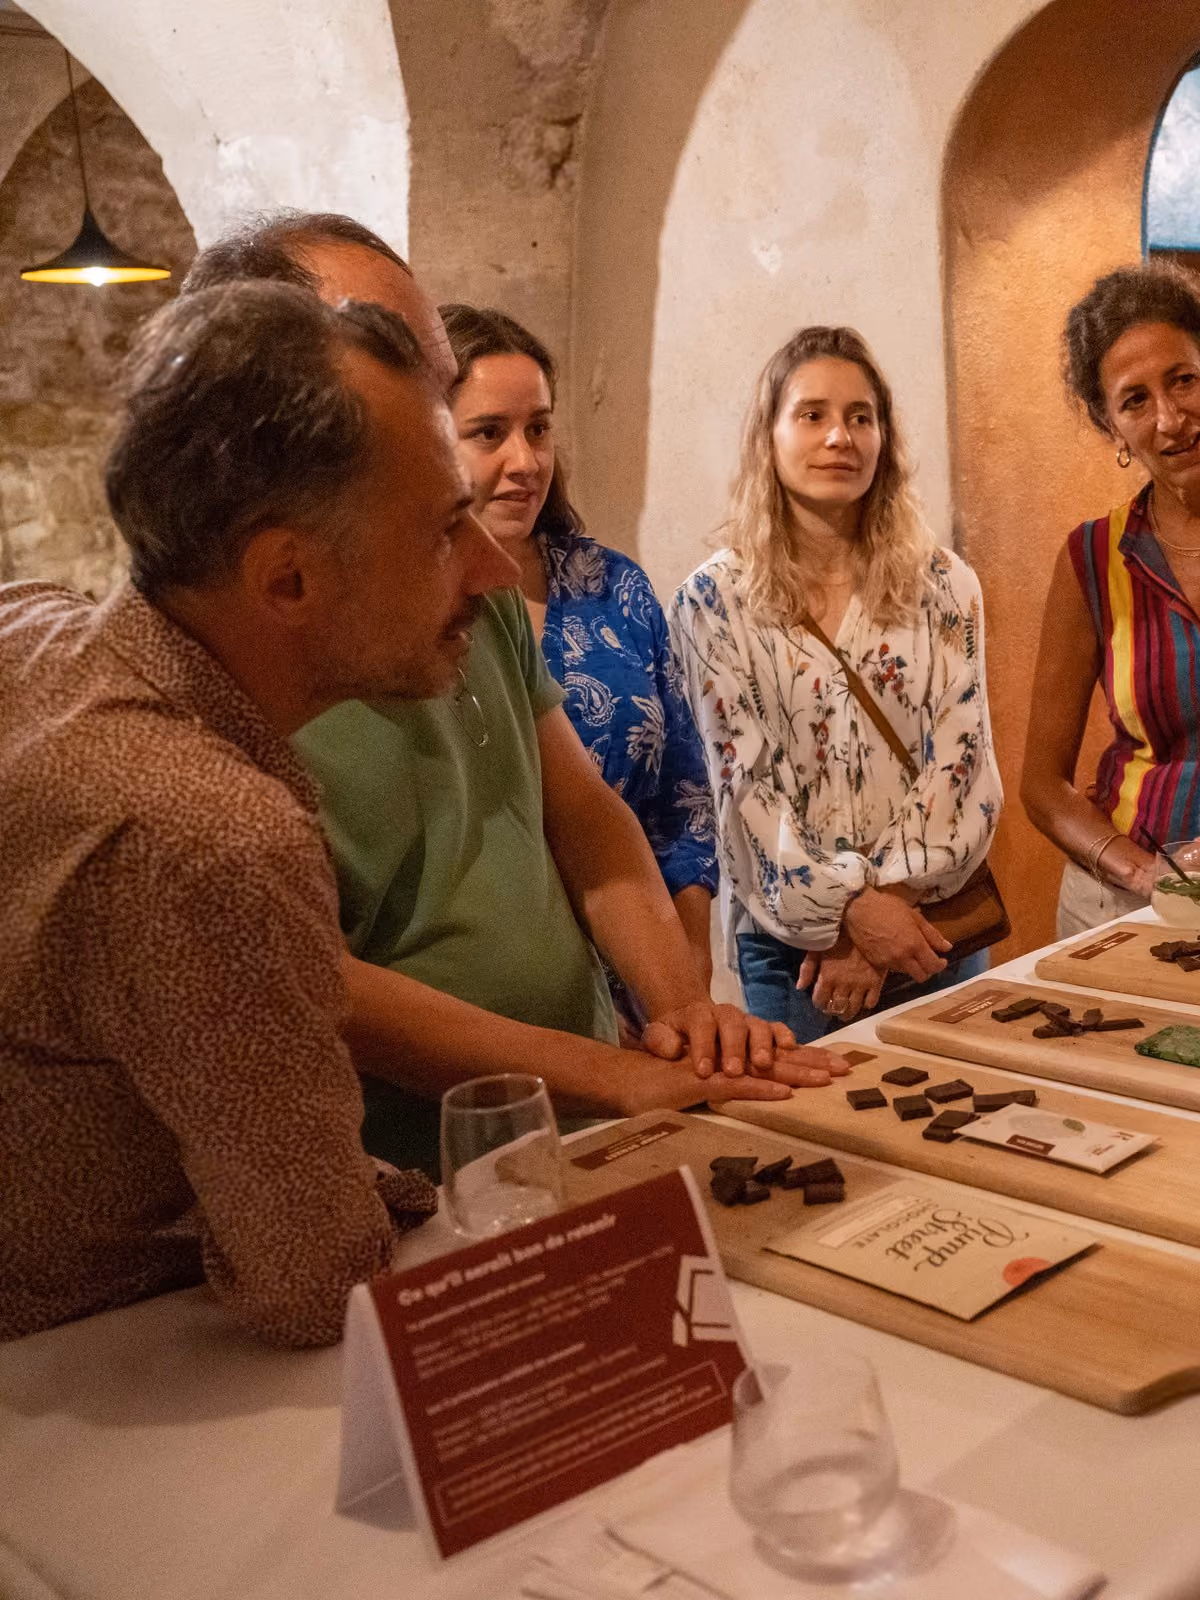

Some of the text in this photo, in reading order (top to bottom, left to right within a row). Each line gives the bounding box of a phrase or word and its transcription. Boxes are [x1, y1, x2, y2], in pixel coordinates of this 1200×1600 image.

[854, 1203, 939, 1249] CHOCOLATE
[885, 1208, 973, 1261] Street
[913, 1217, 1030, 1272] Pump
